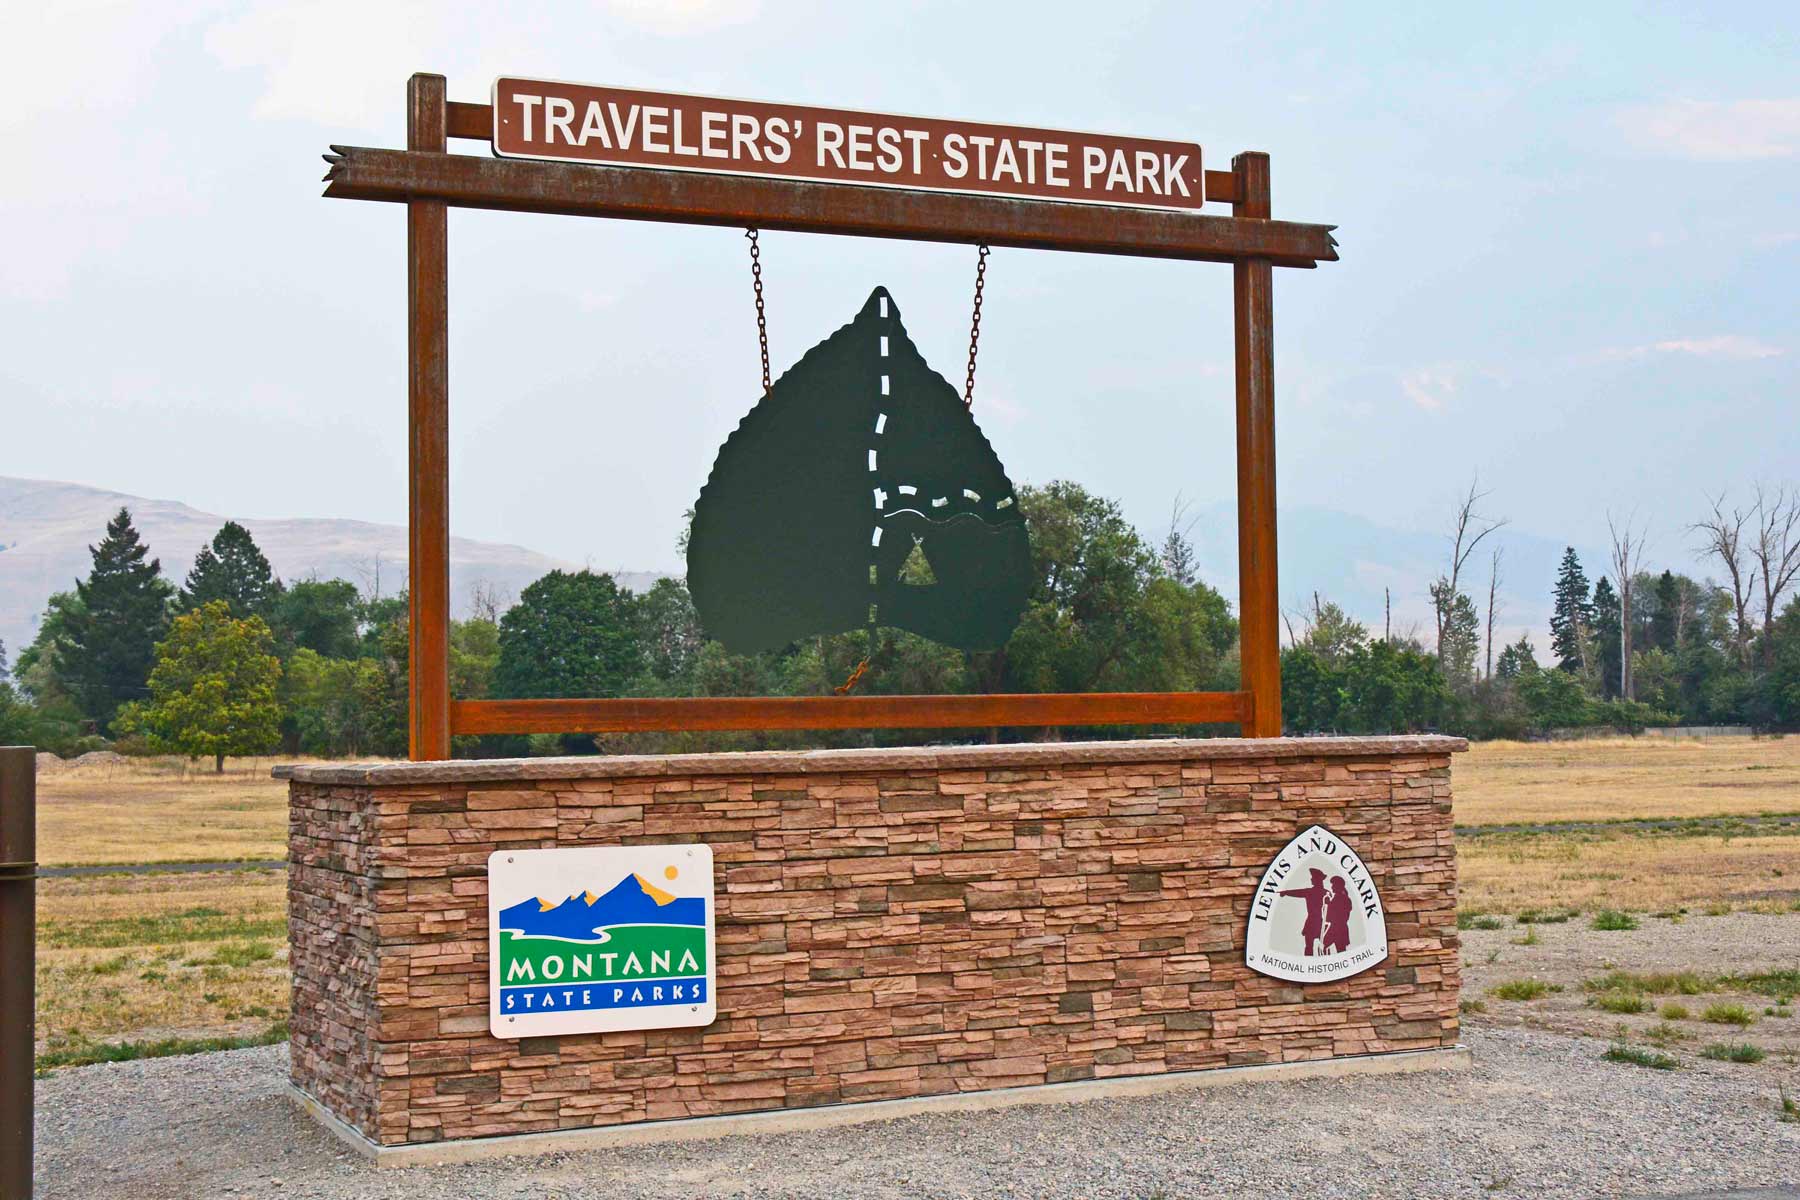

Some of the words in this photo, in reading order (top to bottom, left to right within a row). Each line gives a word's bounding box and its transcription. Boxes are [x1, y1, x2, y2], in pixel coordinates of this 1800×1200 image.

[816, 121, 929, 174] REST
[942, 133, 1070, 187] STATE
[1083, 146, 1190, 197] PARK
[1255, 858, 1291, 922] LEWIS
[1297, 837, 1337, 859] AND
[1340, 854, 1379, 919] CLARK
[506, 948, 700, 982] MONTANA
[1261, 954, 1305, 973] NATIONAL
[1307, 959, 1349, 974] HISTORIC
[1350, 948, 1374, 965] TRAIL
[506, 989, 591, 1009] STATE
[613, 984, 700, 1003] PARKS
